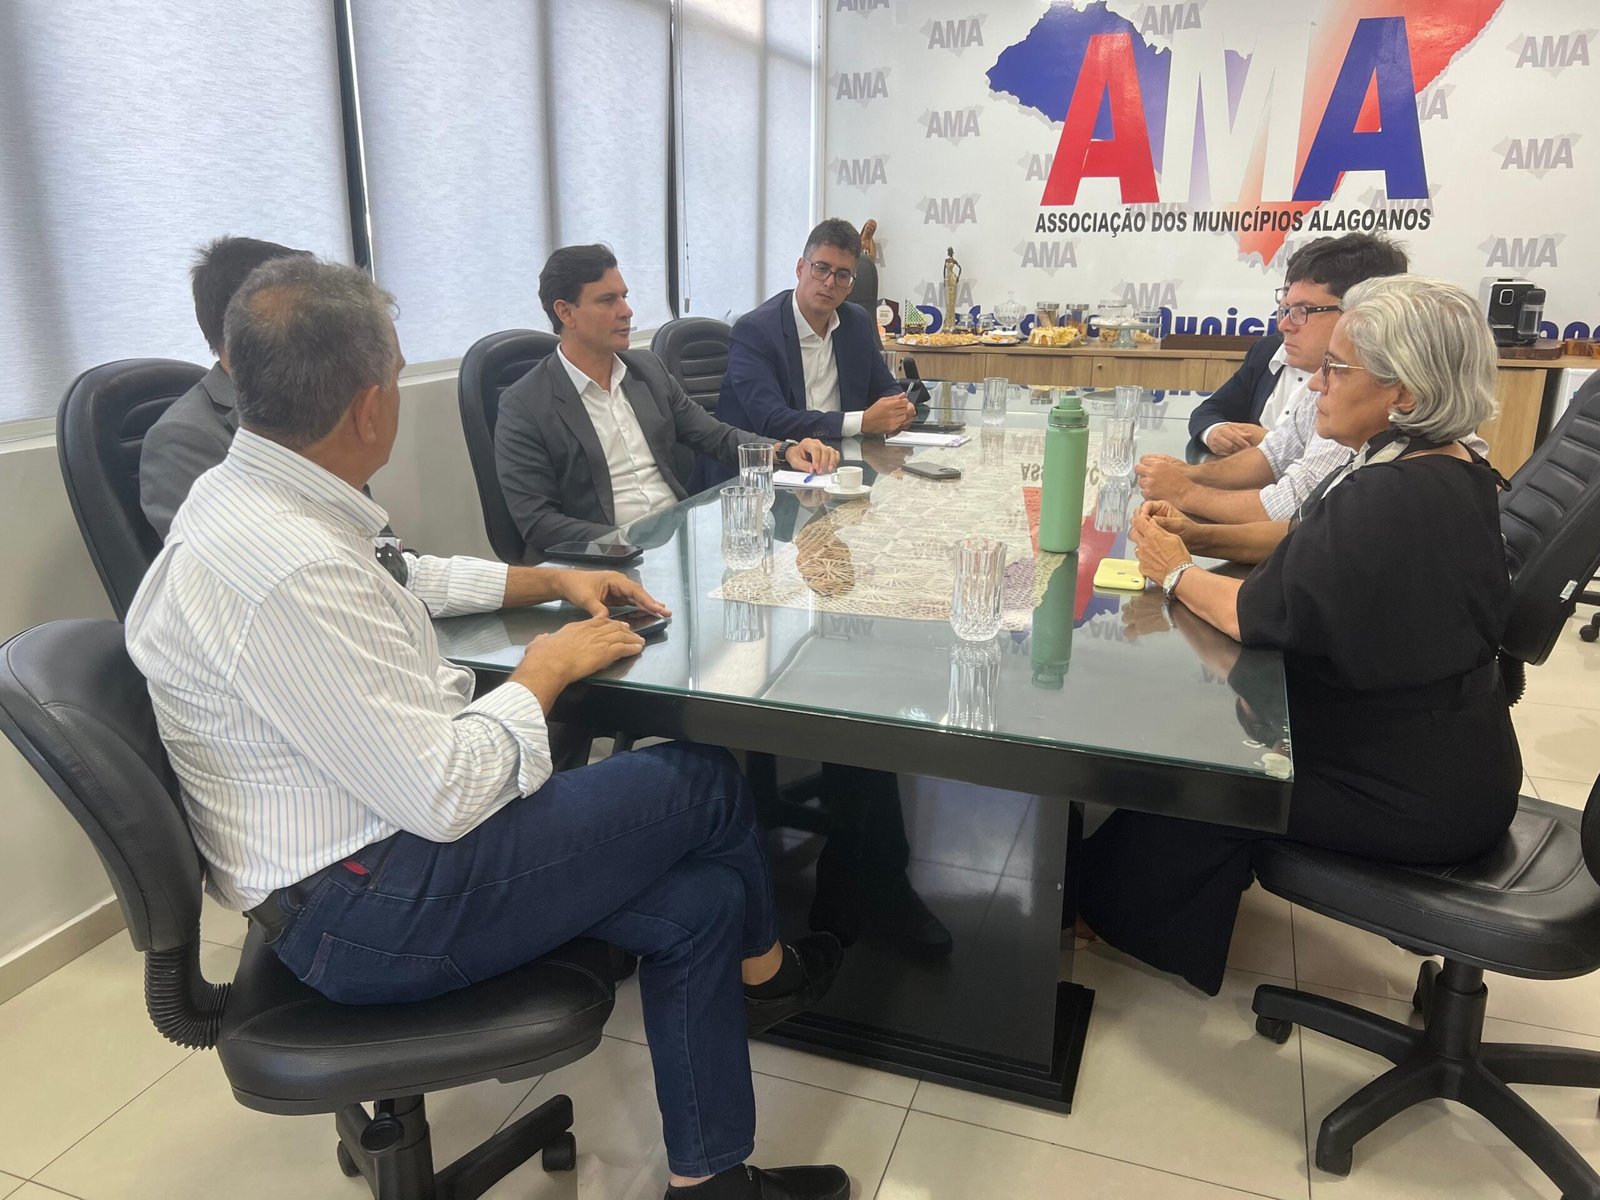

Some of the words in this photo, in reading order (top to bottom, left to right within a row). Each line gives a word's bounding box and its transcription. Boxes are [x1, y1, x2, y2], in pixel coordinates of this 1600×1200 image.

[927, 18, 984, 50] AMA
[1140, 3, 1201, 35] AMA
[1515, 33, 1590, 68] AMA
[836, 71, 888, 100] AMA
[925, 110, 980, 139] AMA
[1040, 16, 1429, 206] AMA
[1501, 138, 1574, 170] AMA
[836, 158, 887, 185] AMA
[923, 197, 977, 225] AMA
[1035, 207, 1146, 238] ASSOCIAÇÃO
[1151, 211, 1187, 232] DOS
[1192, 206, 1304, 232] MUNICÍPIOS
[1308, 208, 1432, 231] ALAGOANOS
[1020, 241, 1077, 268] AMA
[1486, 237, 1558, 268] AMA
[1122, 282, 1178, 310] AMA
